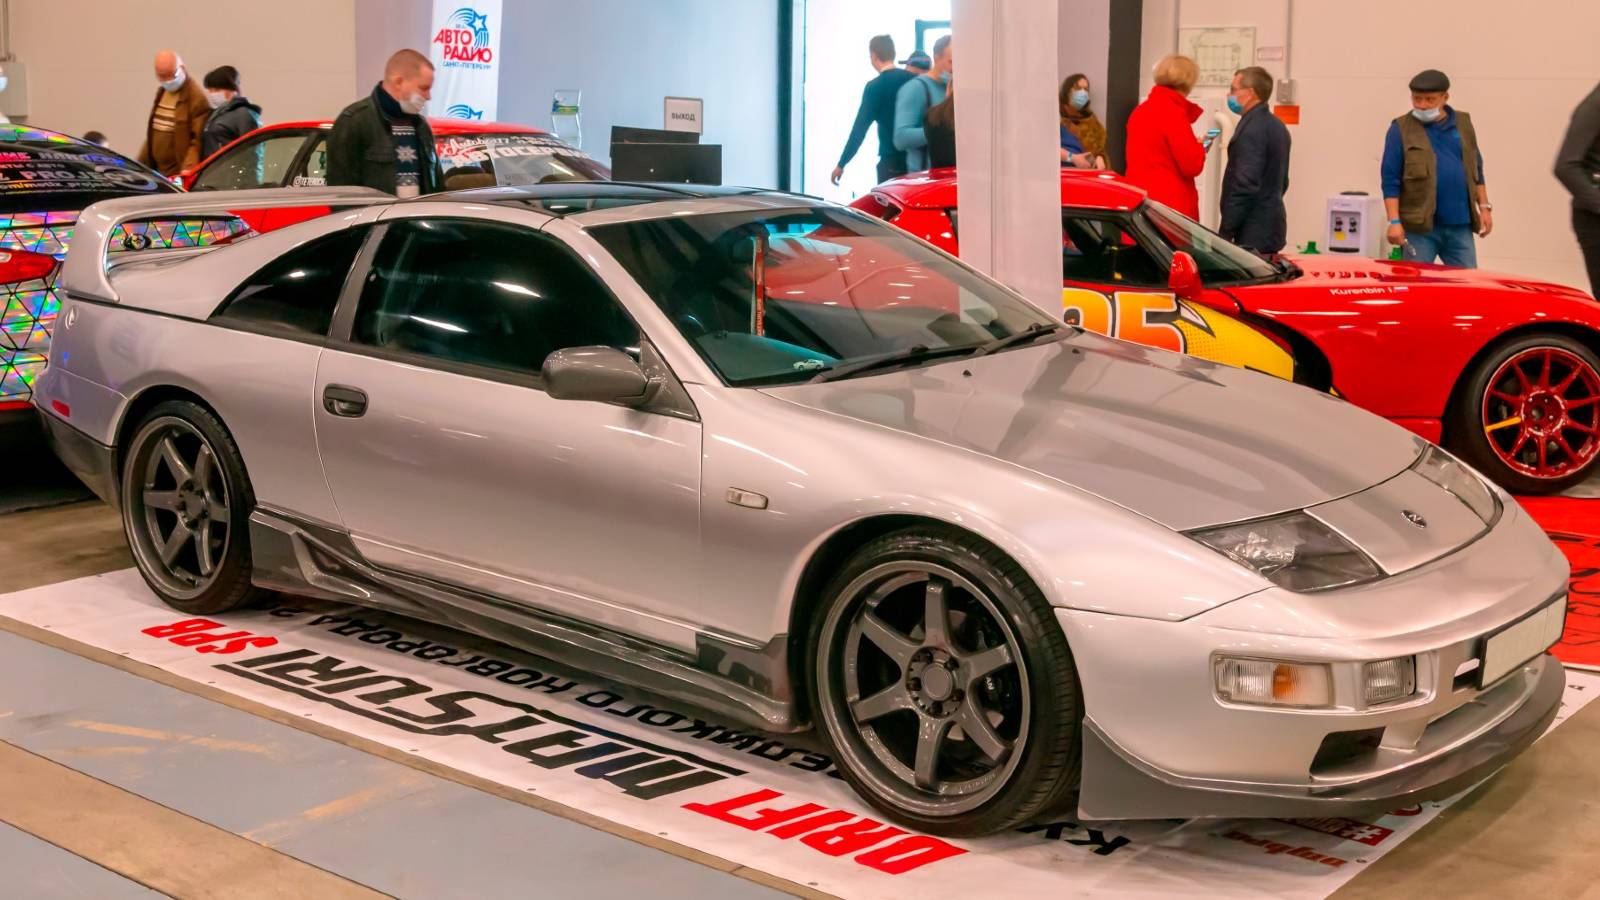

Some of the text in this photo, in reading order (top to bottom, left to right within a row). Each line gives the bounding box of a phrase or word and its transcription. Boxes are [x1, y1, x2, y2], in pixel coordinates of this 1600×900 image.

[433, 29, 472, 45] АВТО
[443, 45, 492, 63] РАДИО
[671, 112, 696, 121] ВЫХОД
[141, 618, 278, 654] SPB
[680, 788, 970, 875] DRIFT
